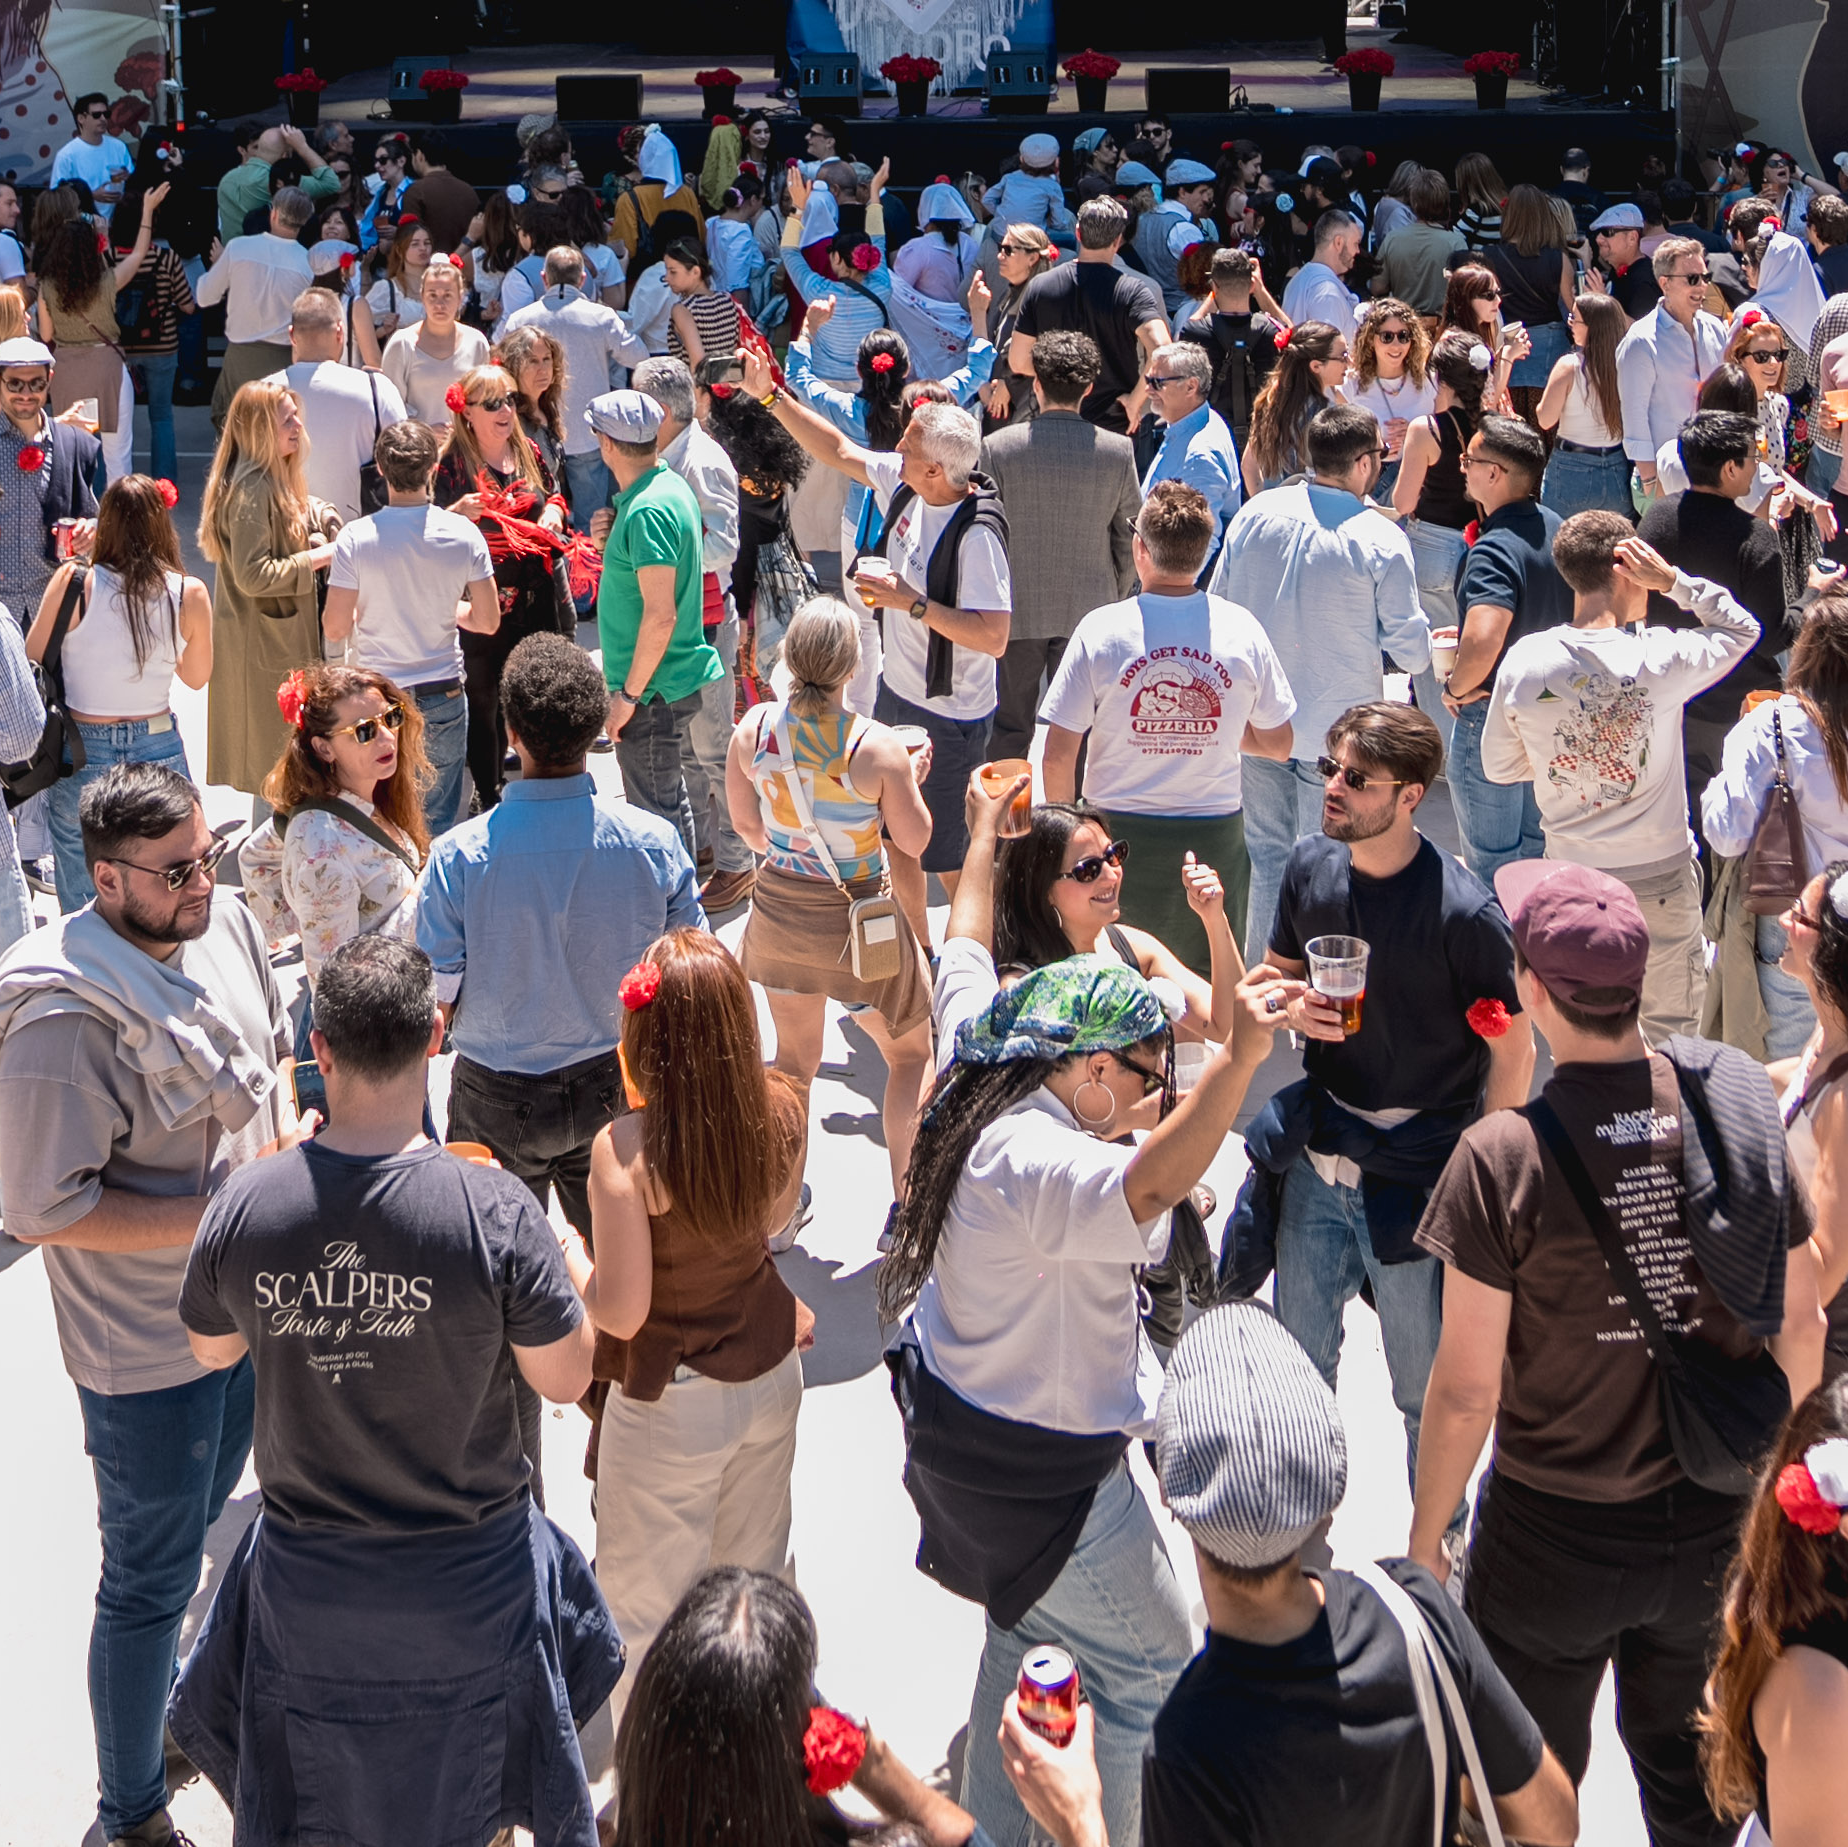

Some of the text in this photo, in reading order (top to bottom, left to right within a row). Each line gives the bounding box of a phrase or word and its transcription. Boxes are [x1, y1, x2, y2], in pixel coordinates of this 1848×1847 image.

[1119, 646, 1232, 689] BOYS GET SAD TOO
[1201, 672, 1221, 690] HOT
[1136, 720, 1214, 732] PIZZERIA
[319, 1240, 367, 1271] The
[254, 1271, 434, 1312] SCALPERS
[268, 1307, 417, 1344] Taste & Talk
[318, 1364, 328, 1372] US
[329, 1362, 344, 1371] FOR
[355, 1351, 370, 1359] OCT
